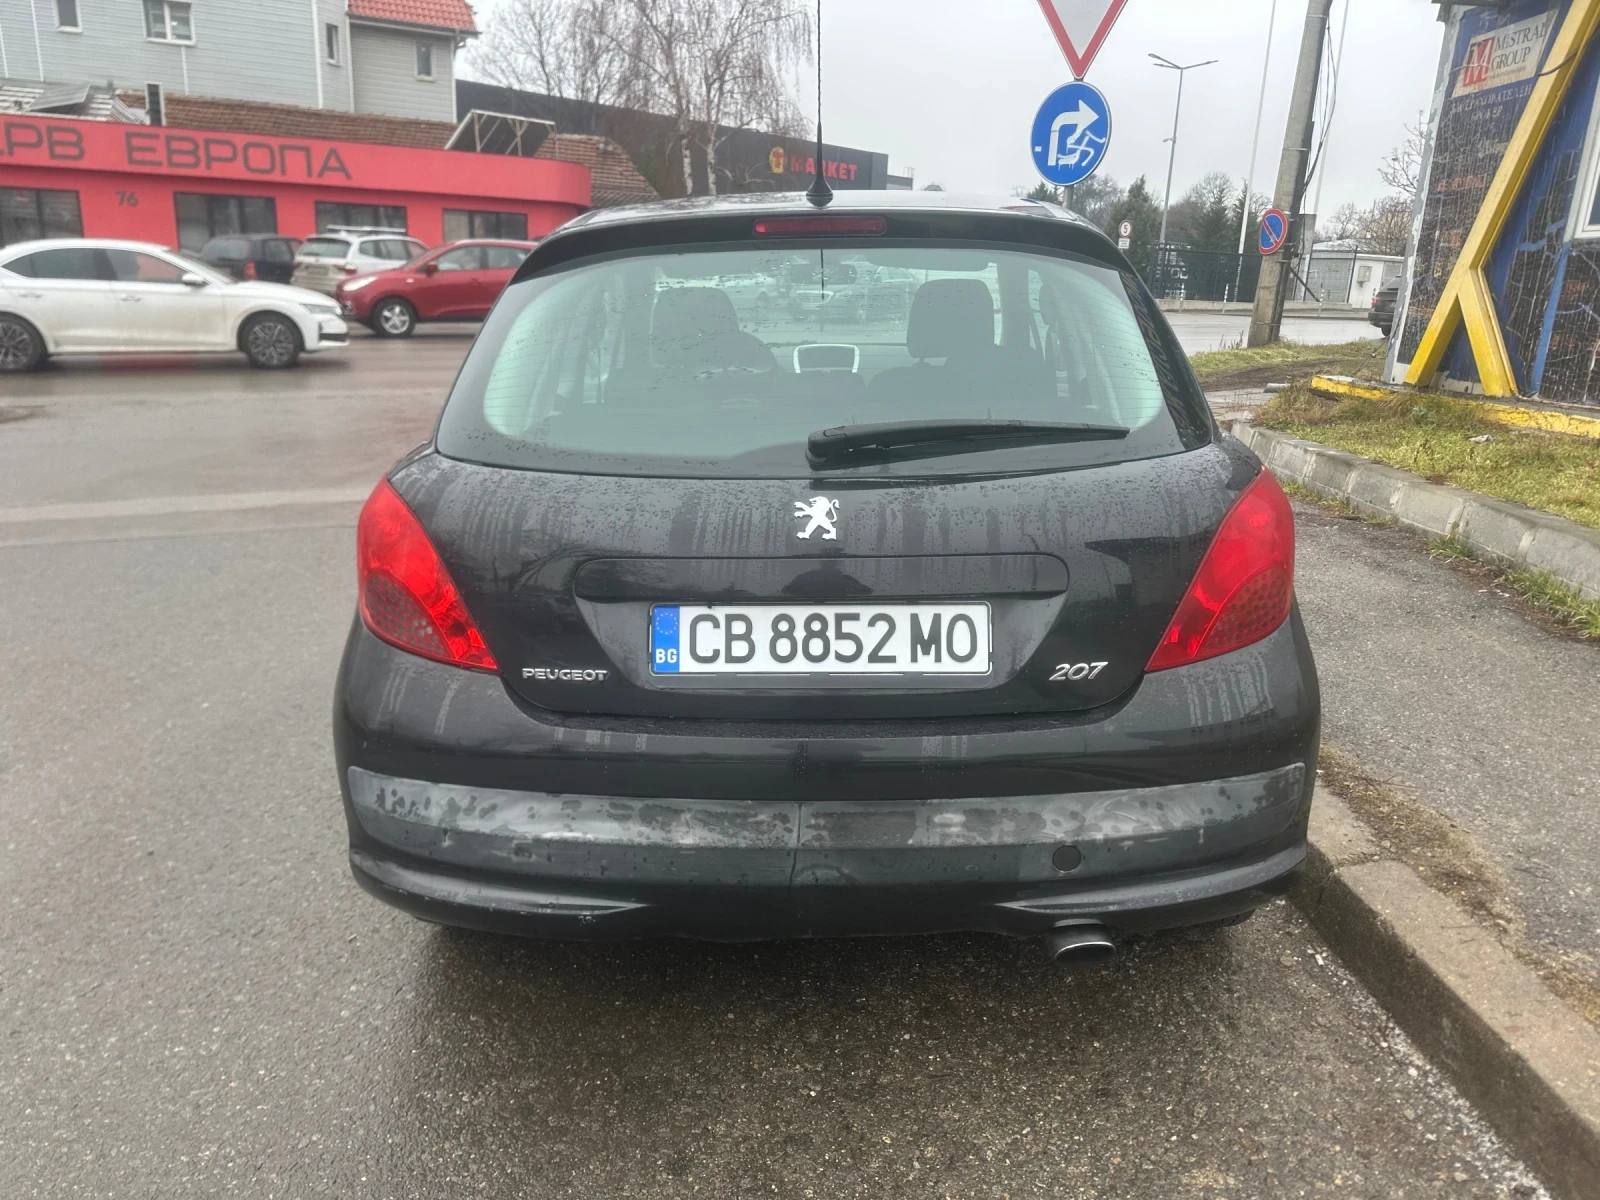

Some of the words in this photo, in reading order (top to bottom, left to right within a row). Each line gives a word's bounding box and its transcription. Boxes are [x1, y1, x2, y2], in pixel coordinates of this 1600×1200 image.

[1491, 46, 1531, 71] GROUP
[0, 121, 85, 160] РВ
[124, 131, 353, 180] ЕВРОПА
[115, 190, 139, 208] 76
[1123, 224, 1128, 234] 5
[689, 613, 756, 663] CB
[769, 613, 897, 663] 8852
[910, 613, 978, 663] MO
[655, 648, 677, 663] BG
[522, 668, 608, 681] PEUGEOT
[1049, 661, 1109, 681] 207
